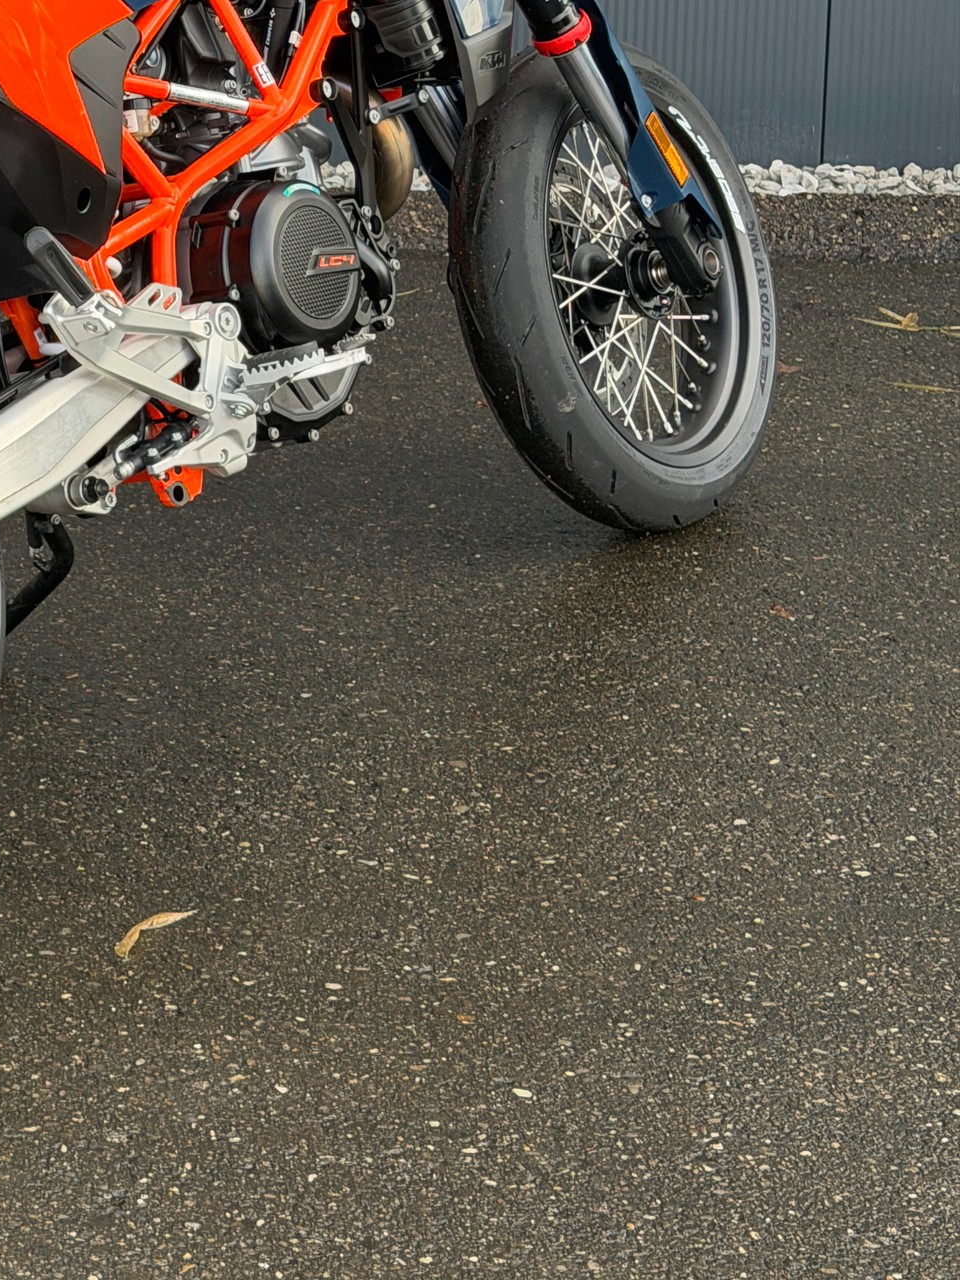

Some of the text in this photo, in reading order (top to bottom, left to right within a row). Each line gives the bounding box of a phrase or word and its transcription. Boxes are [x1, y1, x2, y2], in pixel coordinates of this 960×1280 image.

[479, 50, 506, 72] KTM
[318, 254, 355, 268] LC4
[760, 291, 772, 349] 120/70
